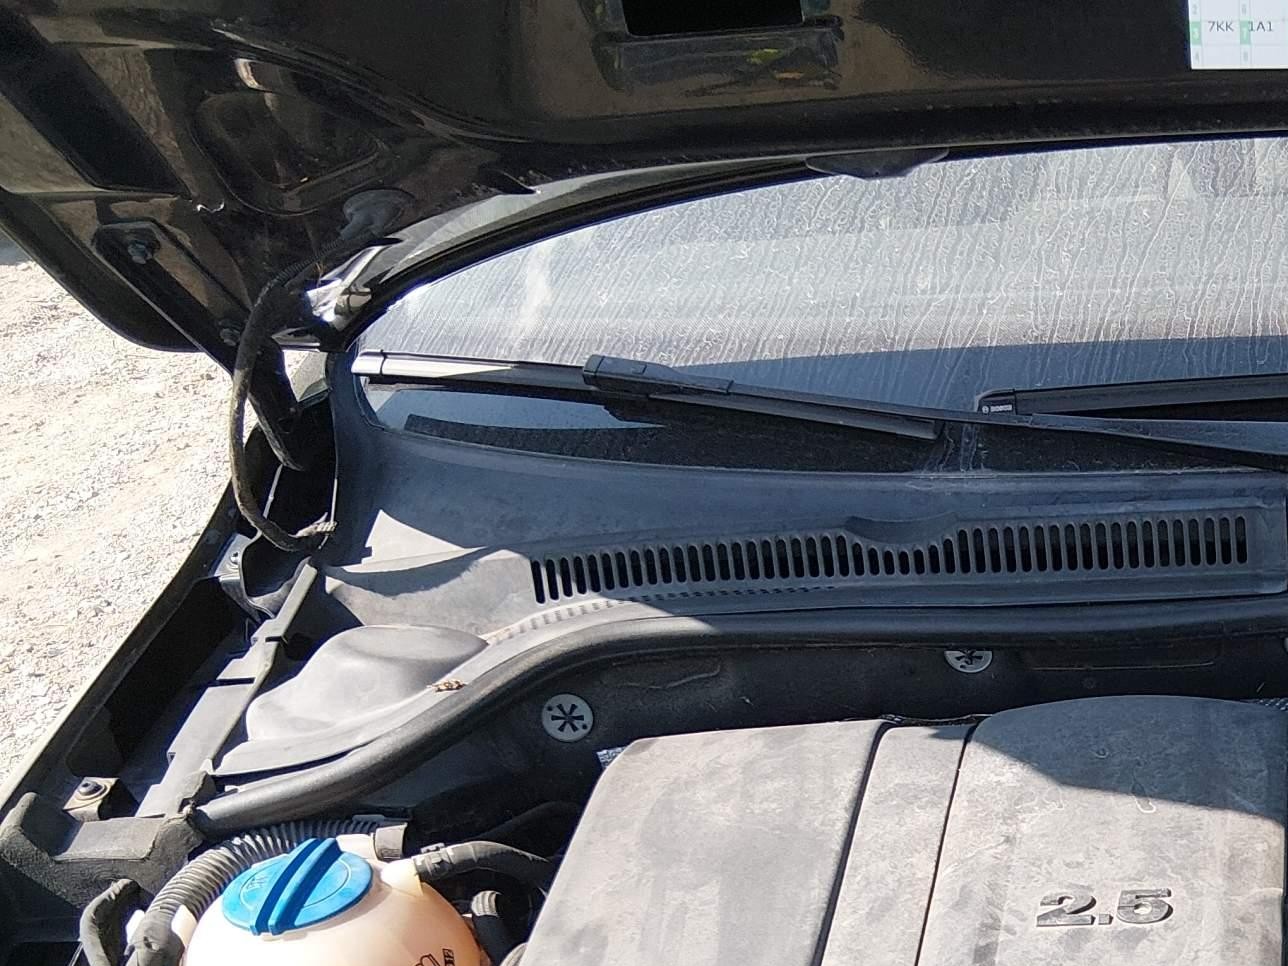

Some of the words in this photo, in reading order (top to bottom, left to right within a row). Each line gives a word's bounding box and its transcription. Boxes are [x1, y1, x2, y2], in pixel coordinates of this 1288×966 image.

[1207, 20, 1234, 32] 7KK
[1248, 20, 1273, 32] 1A1
[1036, 887, 1174, 927] 2.5
